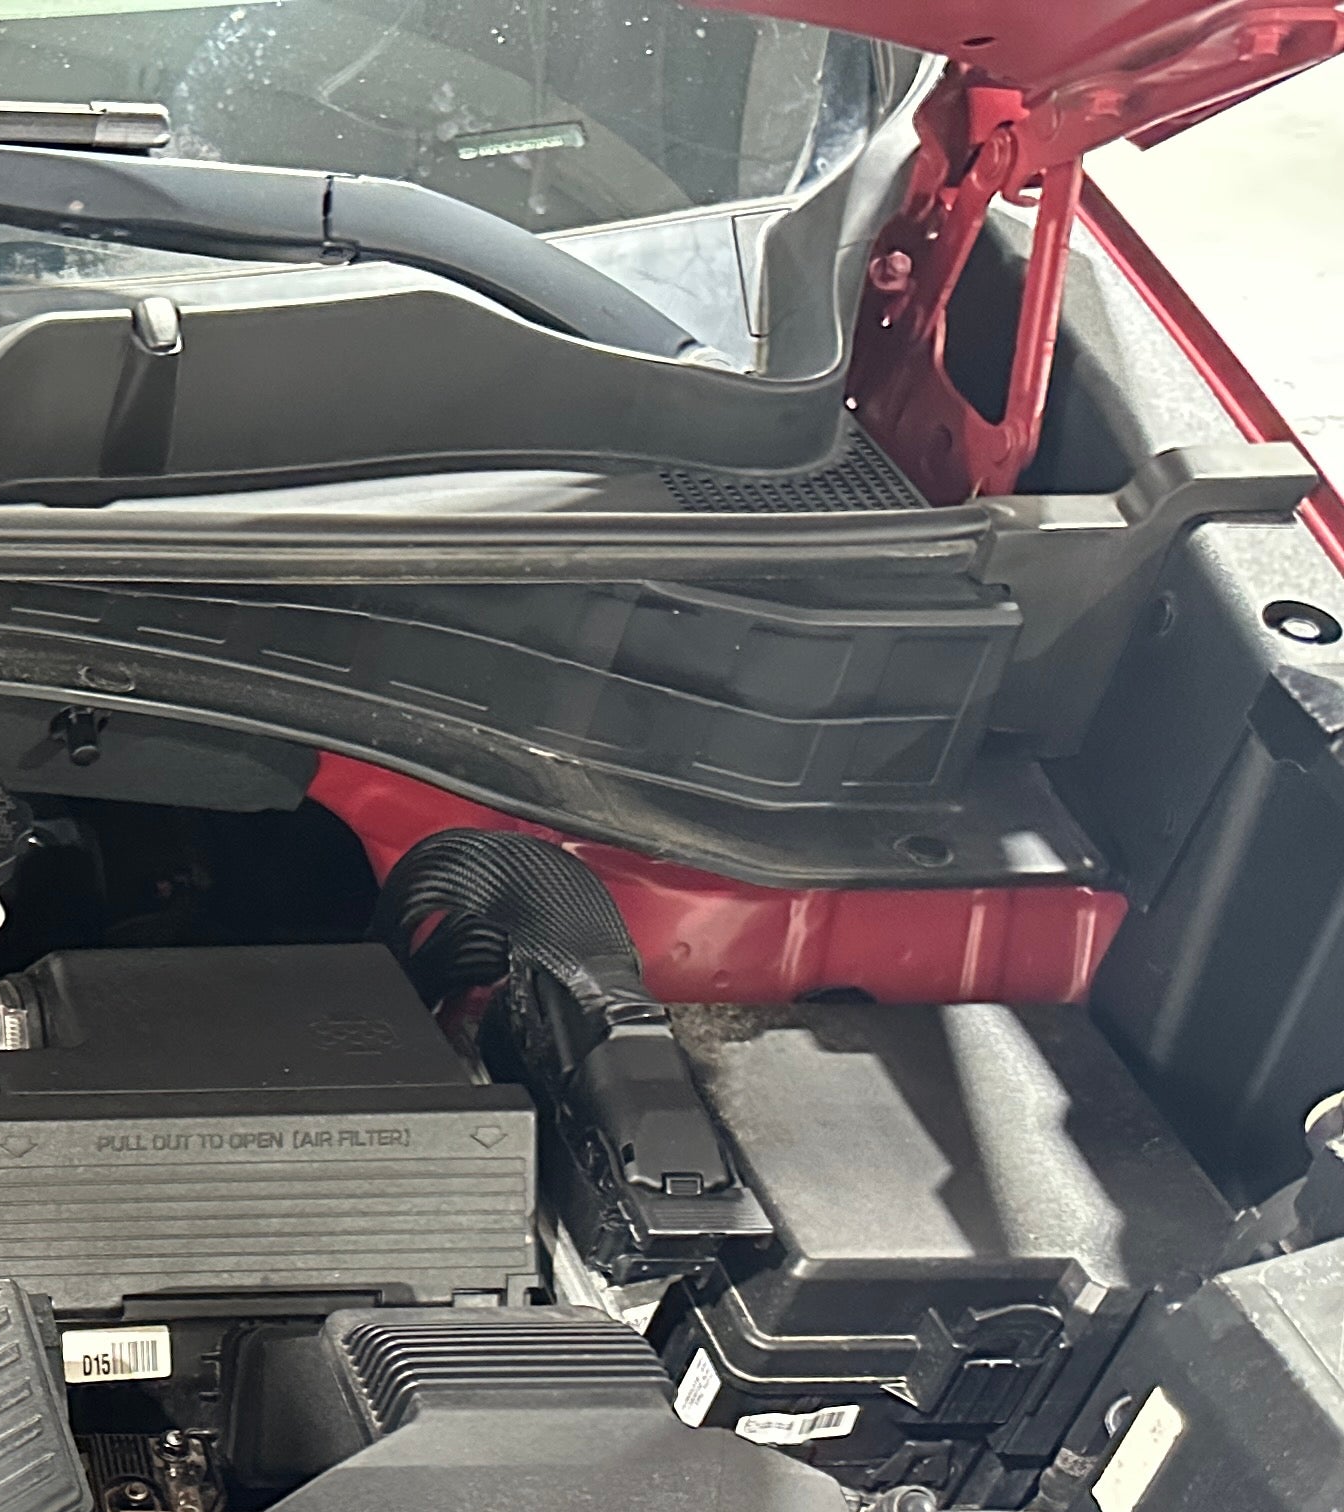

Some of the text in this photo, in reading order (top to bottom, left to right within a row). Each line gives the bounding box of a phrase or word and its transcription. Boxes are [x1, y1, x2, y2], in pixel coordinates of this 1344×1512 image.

[96, 1135, 148, 1152] PULL
[152, 1134, 193, 1151] OUT
[196, 1133, 223, 1150] TO
[229, 1131, 284, 1150] OPEN
[82, 1353, 111, 1377] D15
